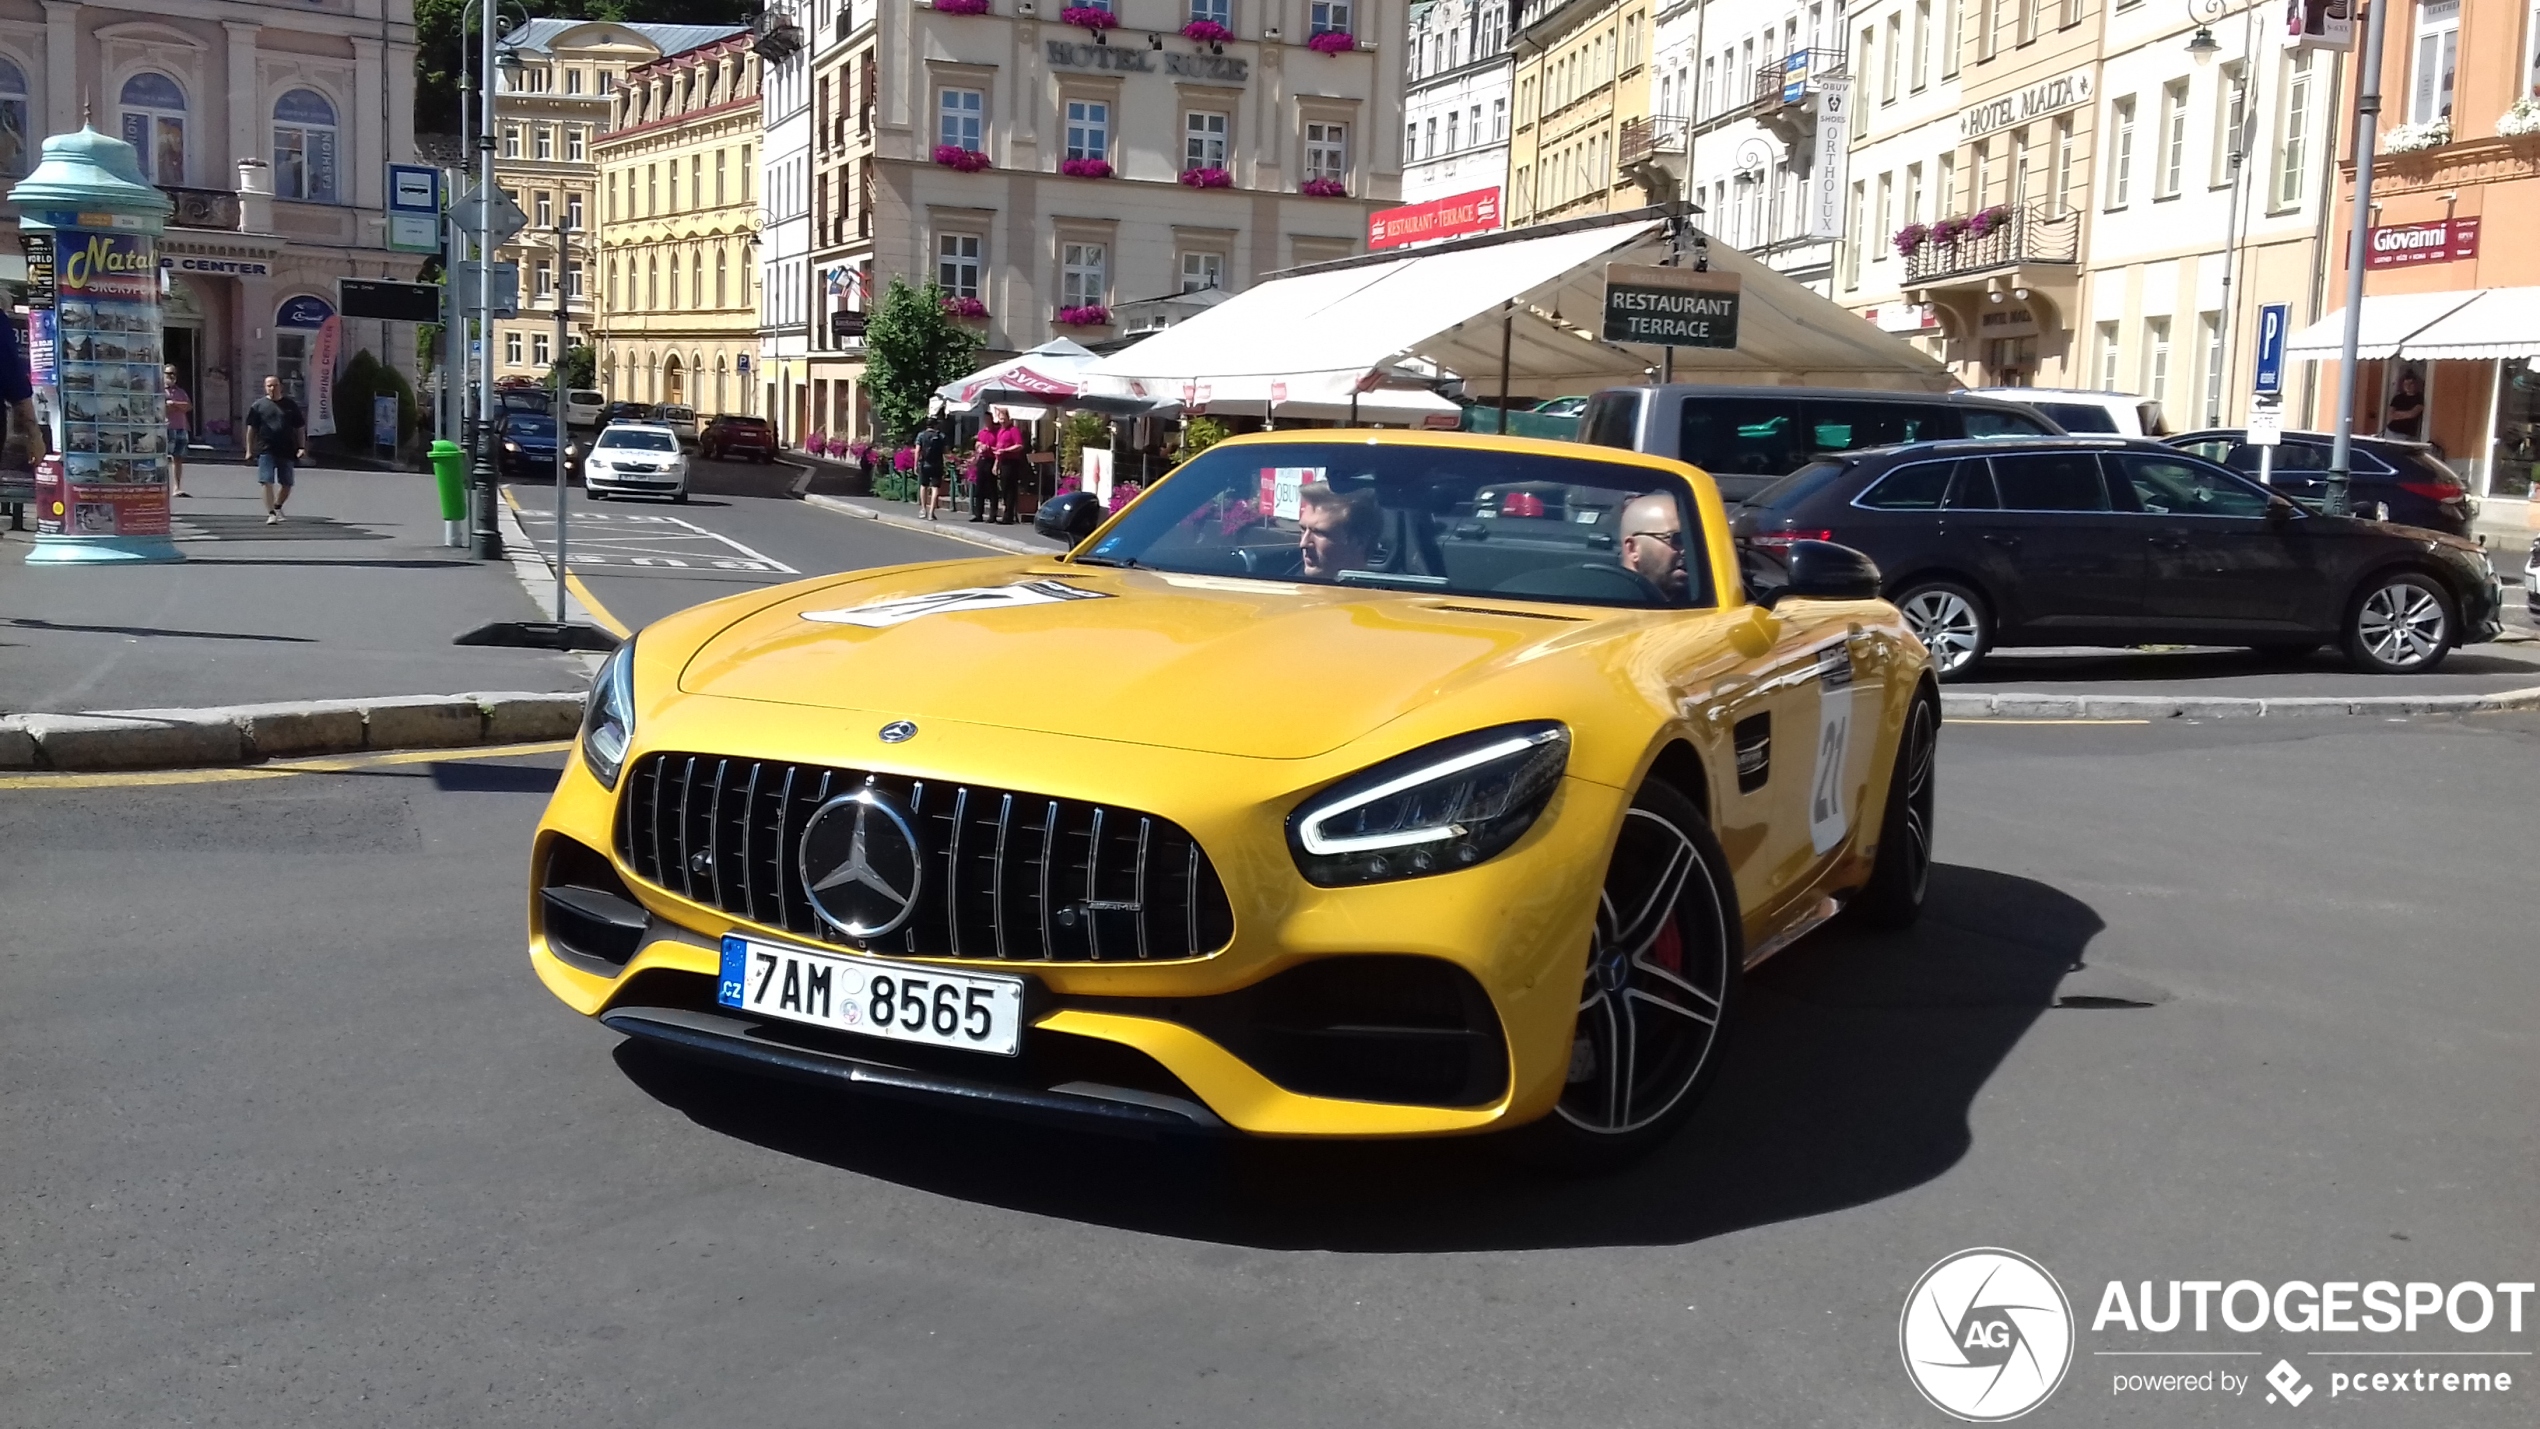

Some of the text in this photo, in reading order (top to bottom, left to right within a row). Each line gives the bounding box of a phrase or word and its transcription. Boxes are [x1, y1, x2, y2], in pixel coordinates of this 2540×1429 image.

[1047, 40, 1155, 73] HOTEL
[1822, 82, 1849, 91] OBUV
[1820, 115, 1846, 124] SHOES
[1969, 75, 2074, 135] HOTEL MALTA
[321, 132, 332, 189] FASHION
[1822, 127, 1837, 230] ORTHOLUX
[1387, 213, 1433, 237] RESTAURANT
[1438, 204, 1474, 227] TERRACE
[2374, 223, 2447, 252] Giovanni
[28, 254, 53, 263] WORLD
[182, 259, 266, 275] CENTER
[1612, 291, 1732, 316] RESTAURANT
[1628, 317, 1709, 338] TERRACE
[2264, 312, 2278, 361] P
[320, 325, 334, 420] SHOPPING CENTER
[739, 356, 748, 367] P
[1814, 716, 1846, 824] 21
[723, 981, 741, 999] CZ
[754, 952, 995, 1042] 7AM 8565
